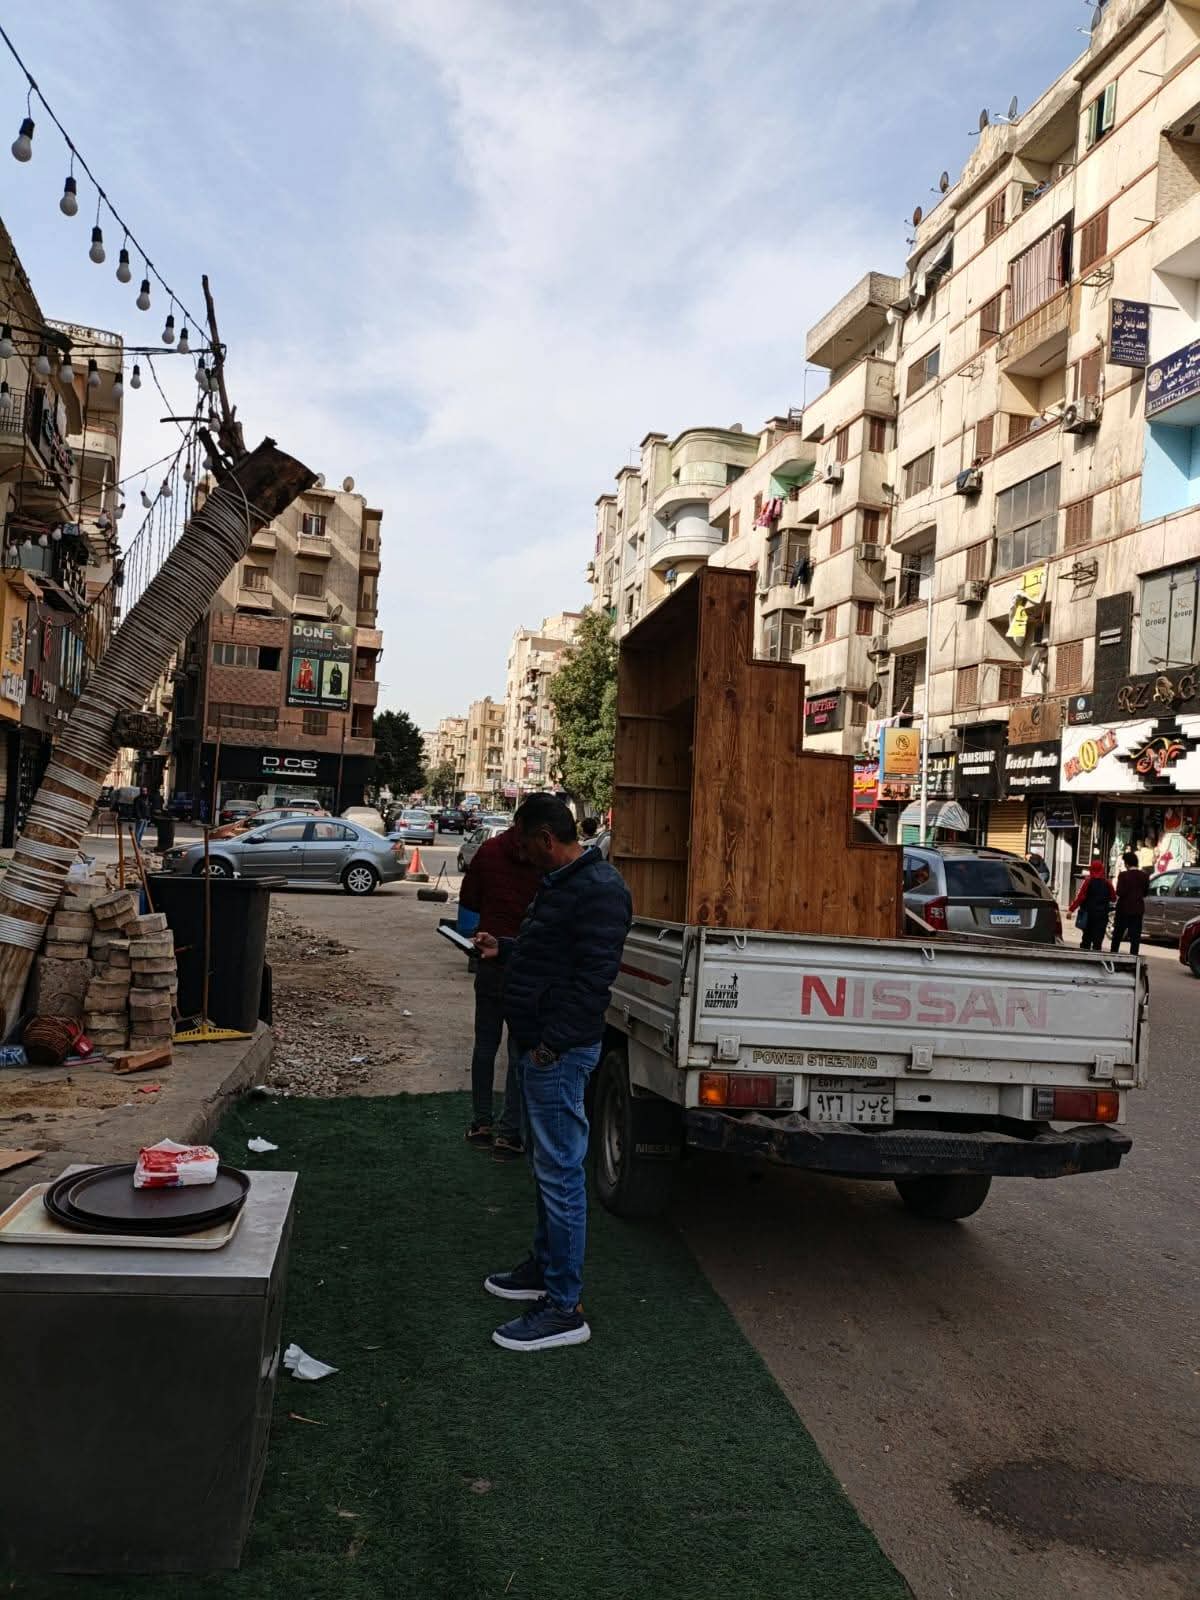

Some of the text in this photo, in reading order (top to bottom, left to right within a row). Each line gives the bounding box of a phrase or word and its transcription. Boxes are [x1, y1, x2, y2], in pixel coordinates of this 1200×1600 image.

[1163, 359, 1183, 380] خليل
[1145, 617, 1167, 627] Group
[1174, 609, 1192, 619] Group
[293, 625, 333, 640] DONE
[958, 751, 996, 764] SAMSUNG
[800, 975, 1048, 1029] NISSAN
[752, 1050, 878, 1070] POWER STEERING
[817, 1094, 843, 1112] ٩٣٦
